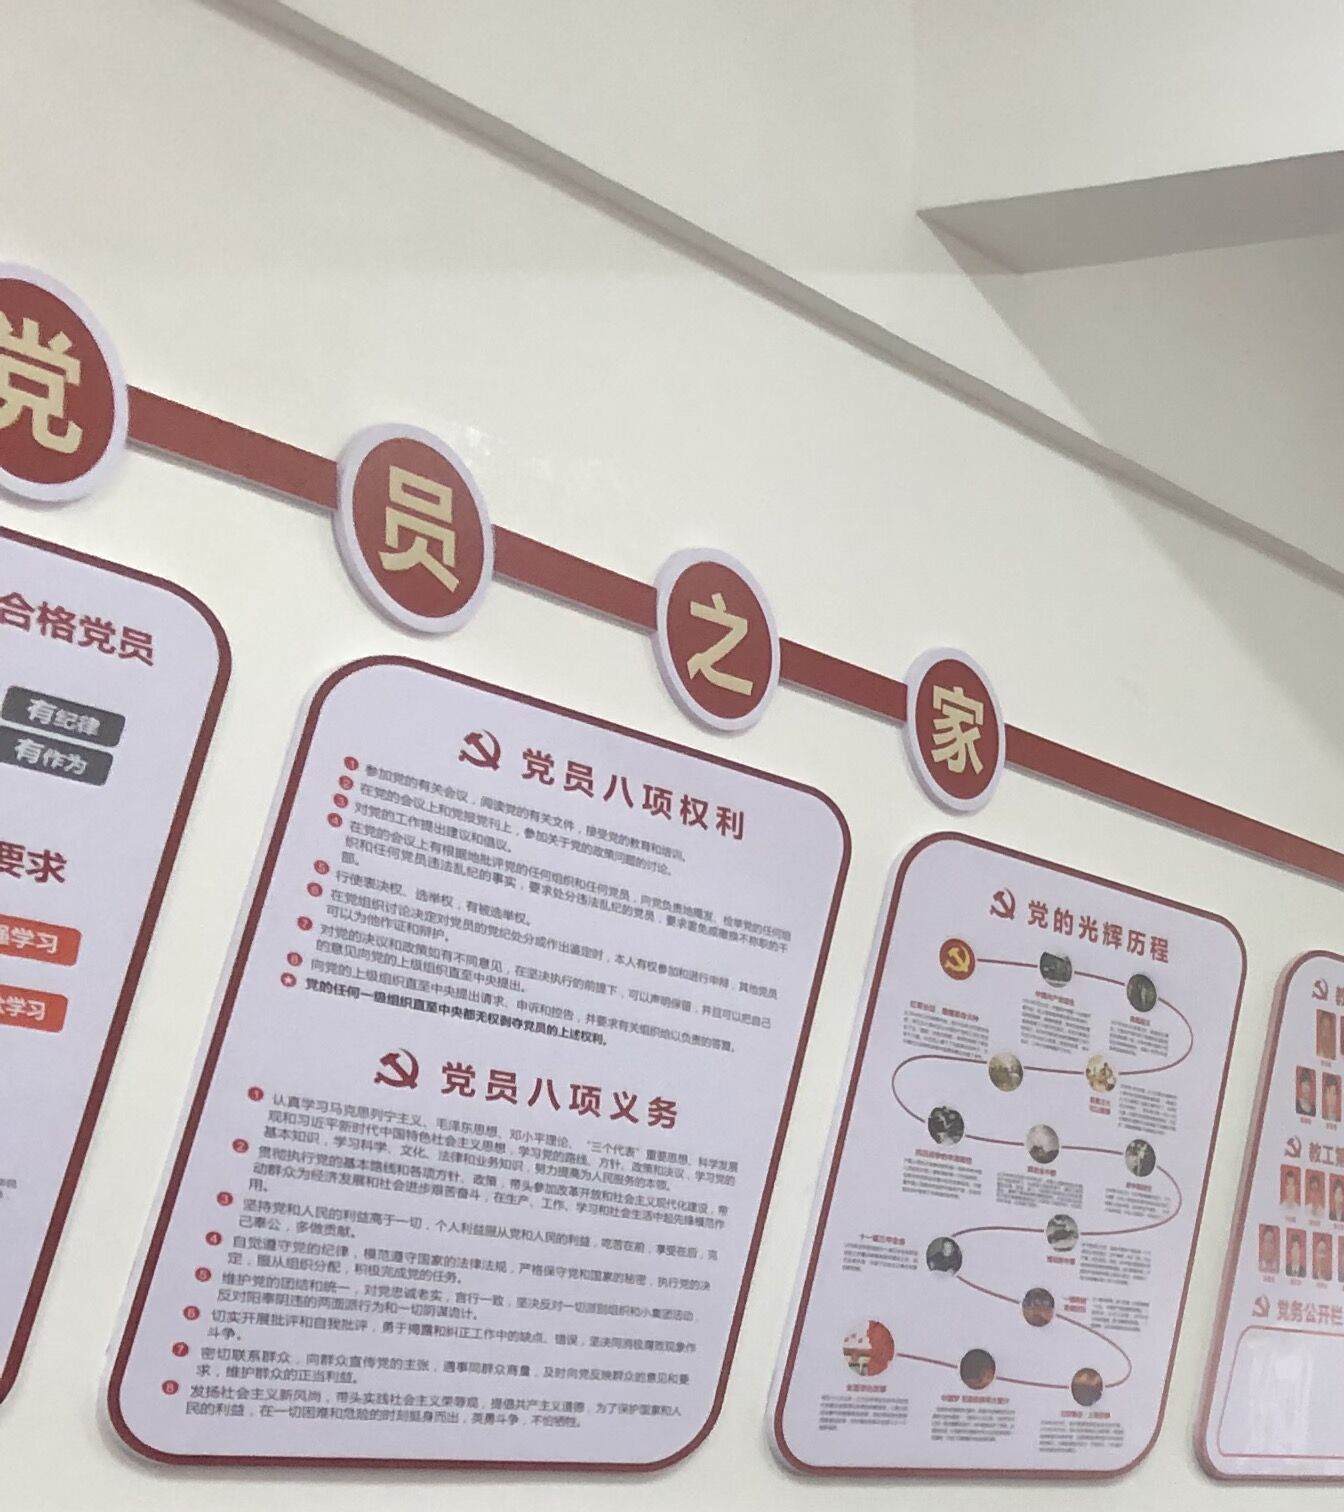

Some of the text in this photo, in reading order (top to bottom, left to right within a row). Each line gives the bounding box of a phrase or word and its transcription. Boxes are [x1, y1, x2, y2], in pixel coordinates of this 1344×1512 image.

[0, 311, 984, 775] 党 员 之 家
[0, 592, 154, 667] 合格党员
[27, 699, 101, 736] 有纪律
[14, 738, 88, 775] 有作为
[521, 748, 744, 840] 党员八项权利
[1027, 900, 1169, 964] 党的光辉历程
[0, 995, 46, 1021] 学习
[441, 1061, 678, 1130] 党员八项义务
